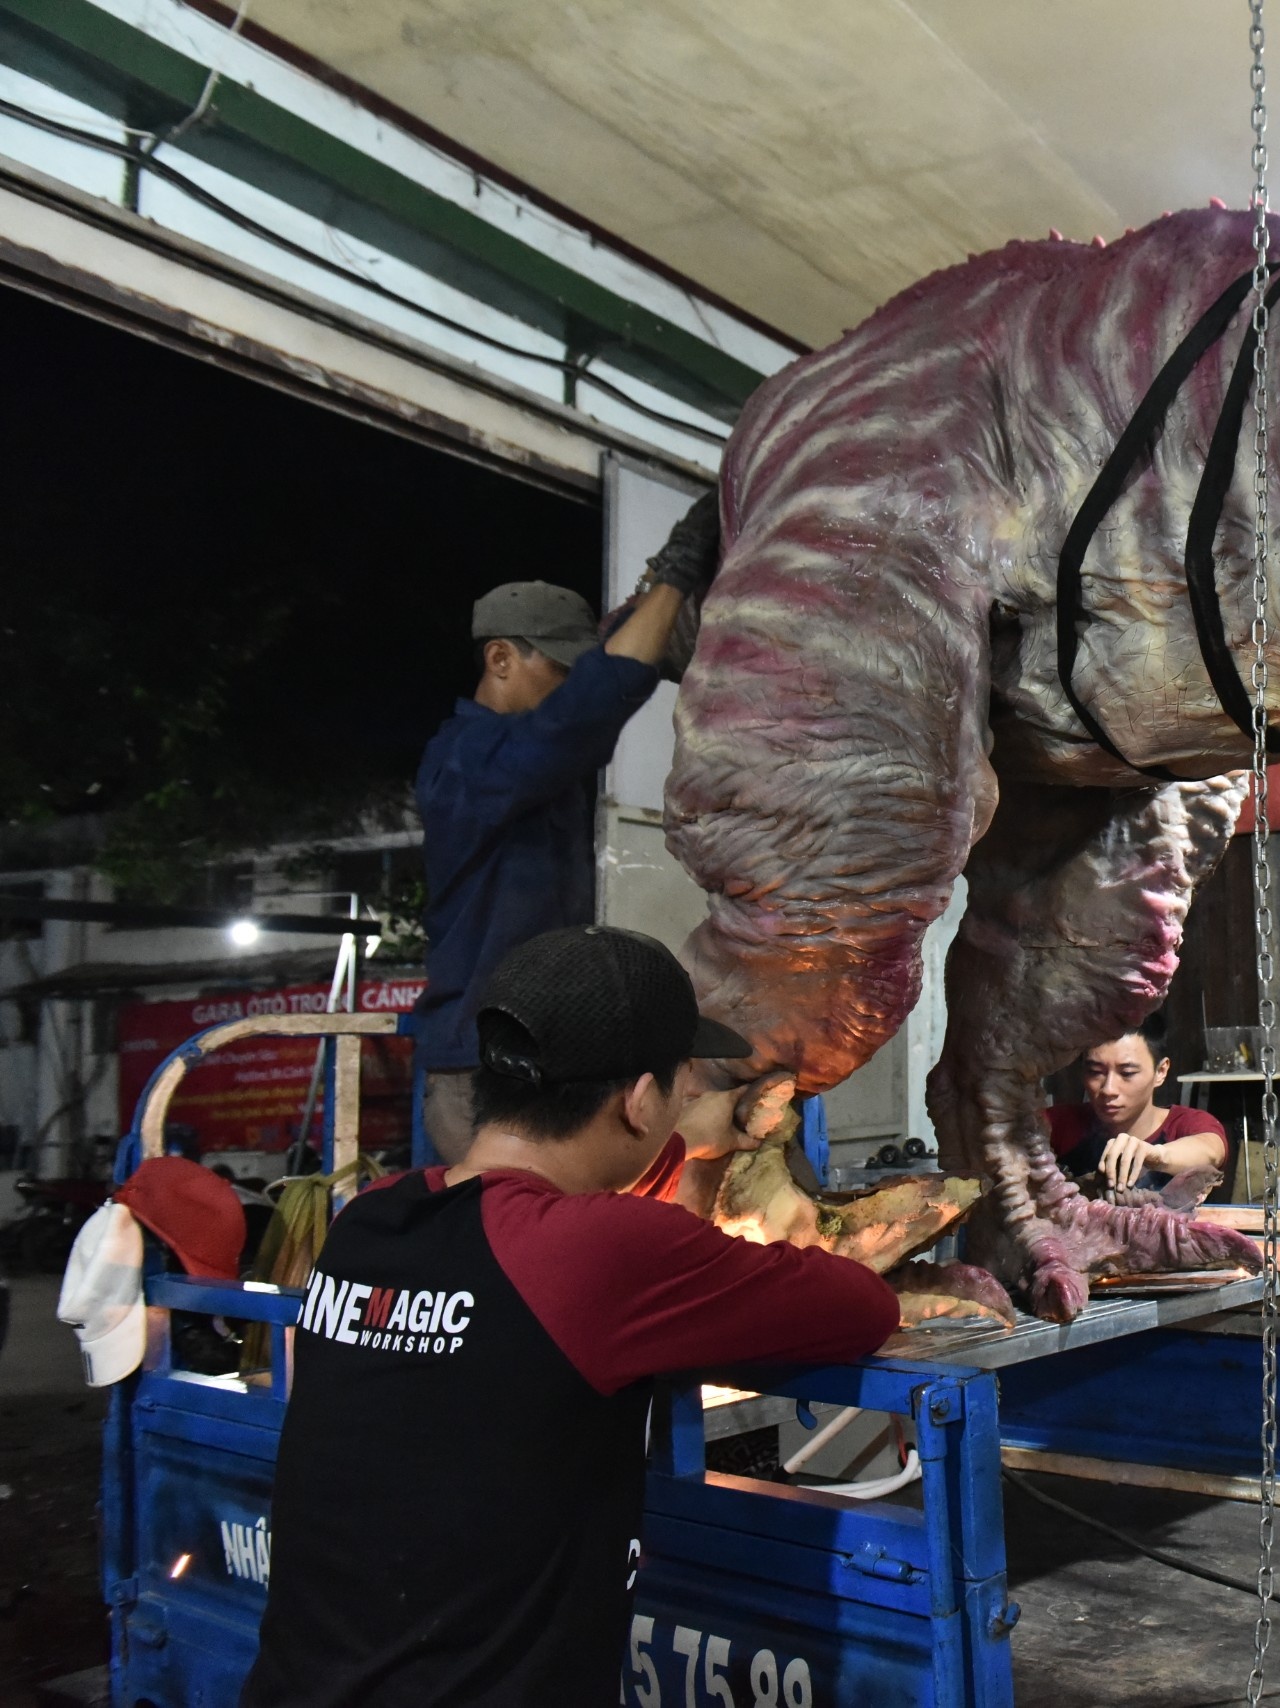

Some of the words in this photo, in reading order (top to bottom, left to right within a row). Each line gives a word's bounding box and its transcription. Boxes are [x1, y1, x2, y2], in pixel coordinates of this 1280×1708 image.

[192, 1001, 242, 1024] GARA
[288, 990, 352, 1012] TRO
[297, 1267, 475, 1345] INEMAGIC
[360, 1329, 464, 1354] WORKSHOP
[620, 1614, 662, 1708] 5
